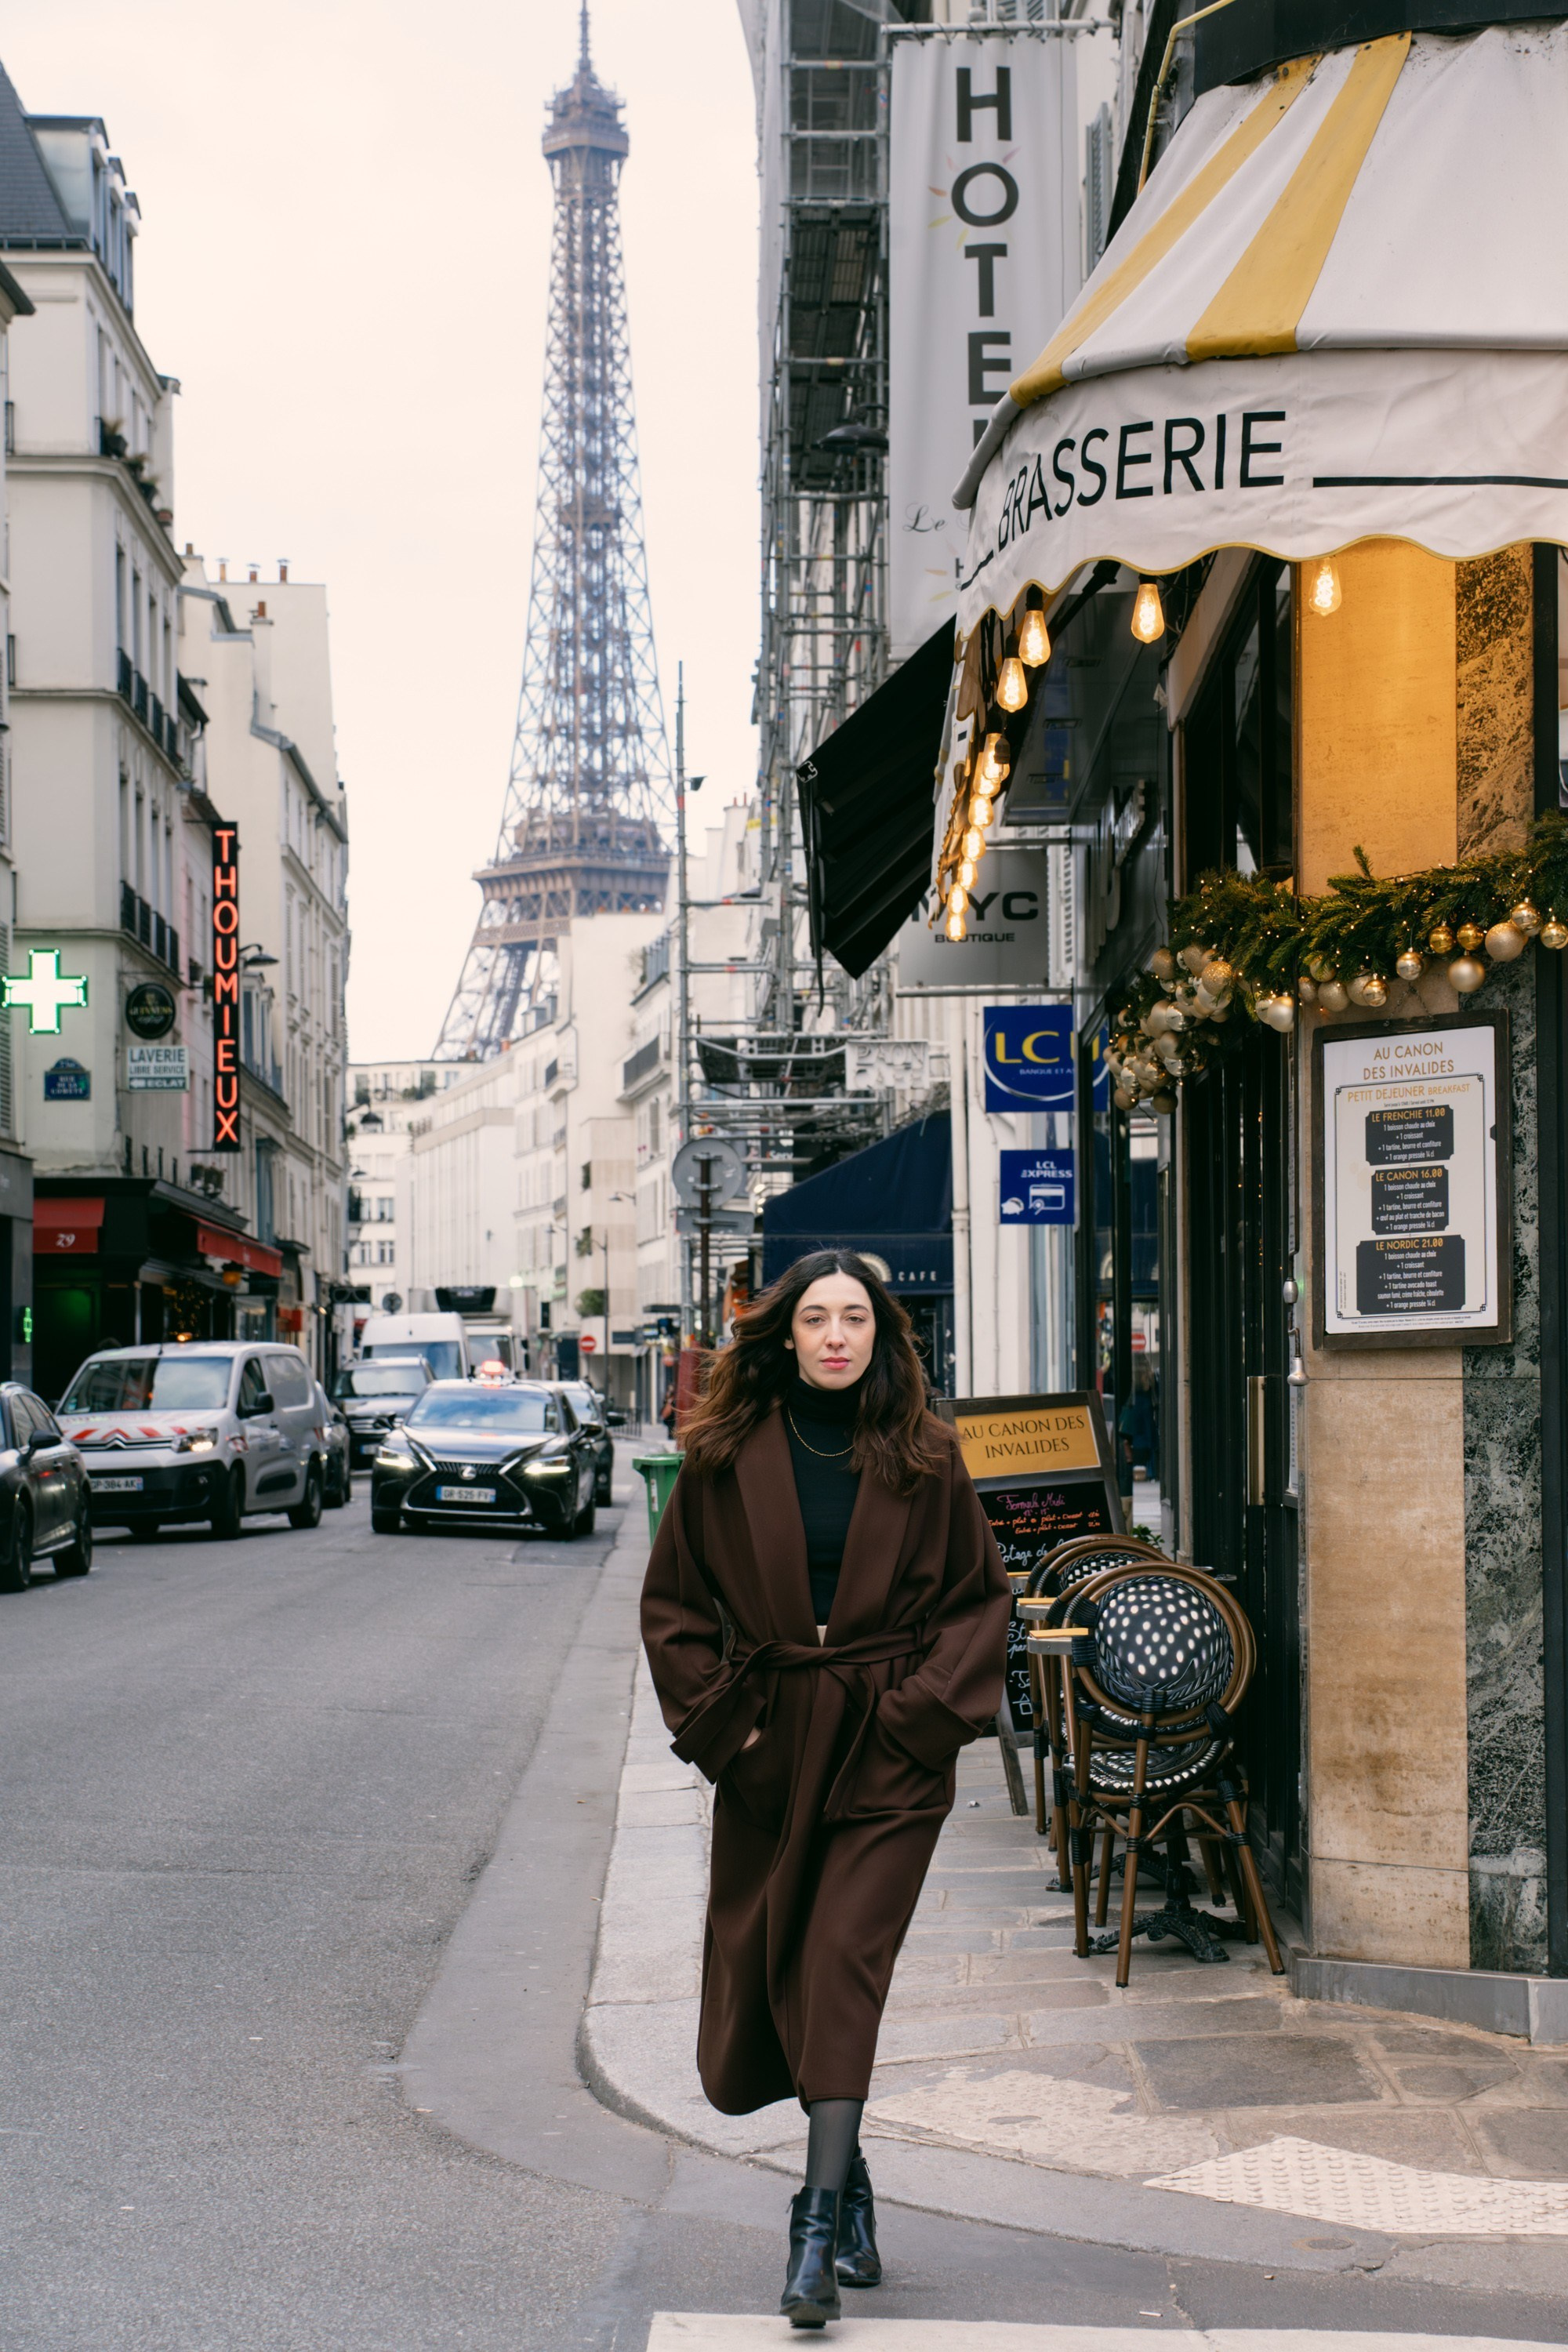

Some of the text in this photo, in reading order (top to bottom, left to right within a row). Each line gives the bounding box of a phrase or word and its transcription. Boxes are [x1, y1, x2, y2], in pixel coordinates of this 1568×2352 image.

[998, 410, 1287, 552] BRASSERIE
[902, 502, 949, 533] Le
[212, 829, 239, 1143] THOUMIEUX
[129, 1049, 185, 1063] LAVERIE
[1374, 1041, 1443, 1061] AU CANON
[129, 1065, 185, 1075] LIBRE SERVICE
[1363, 1059, 1455, 1080] DES INVALIDES
[147, 1079, 185, 1087] ECLAT
[1348, 1083, 1471, 1102] PETIT DEJEUNER BREAKFAST
[1372, 1107, 1446, 1122] LE FRENCHIE 11.00
[1392, 1153, 1407, 1162] orange
[1036, 1160, 1058, 1170] LCL
[1021, 1169, 1073, 1178] EXPRESS
[1375, 1168, 1443, 1182] LE CANON 16.00
[1404, 1192, 1424, 1200] croissant
[1393, 1223, 1408, 1232] orange
[55, 1233, 76, 1248] 79
[1376, 1237, 1444, 1250] LE NORDIC 21.00
[1404, 1261, 1425, 1269] croissant
[898, 1271, 937, 1282] CAFE
[1393, 1301, 1409, 1310] orange
[964, 1415, 1086, 1439] AU CANON DES
[985, 1437, 1070, 1459] INVALIDES
